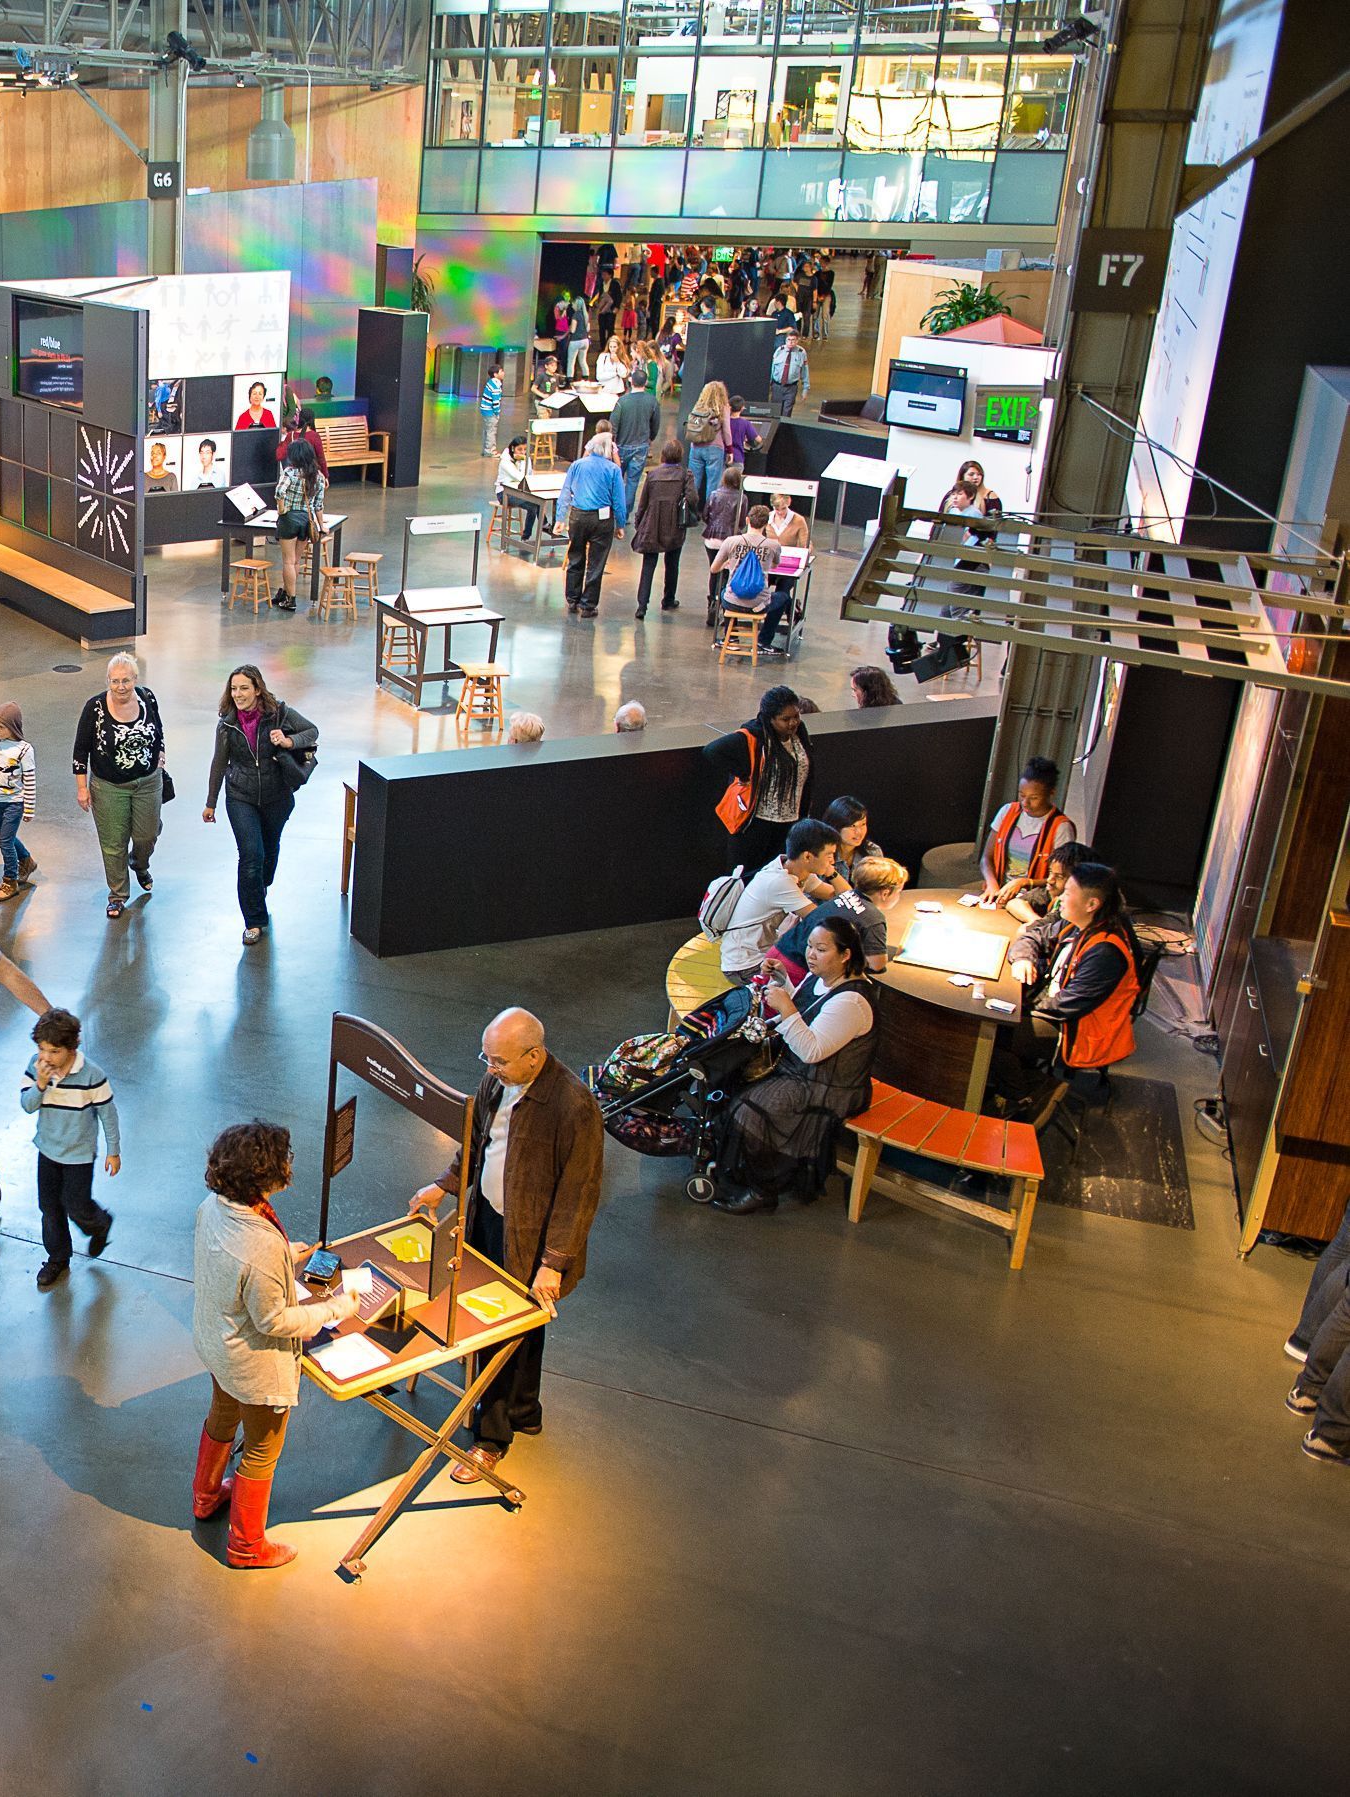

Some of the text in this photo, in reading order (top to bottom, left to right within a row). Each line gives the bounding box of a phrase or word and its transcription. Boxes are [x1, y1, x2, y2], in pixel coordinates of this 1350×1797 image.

[154, 172, 172, 188] G6
[1098, 254, 1144, 288] F7
[40, 336, 60, 350] red/blue
[985, 396, 1030, 427] EXIT
